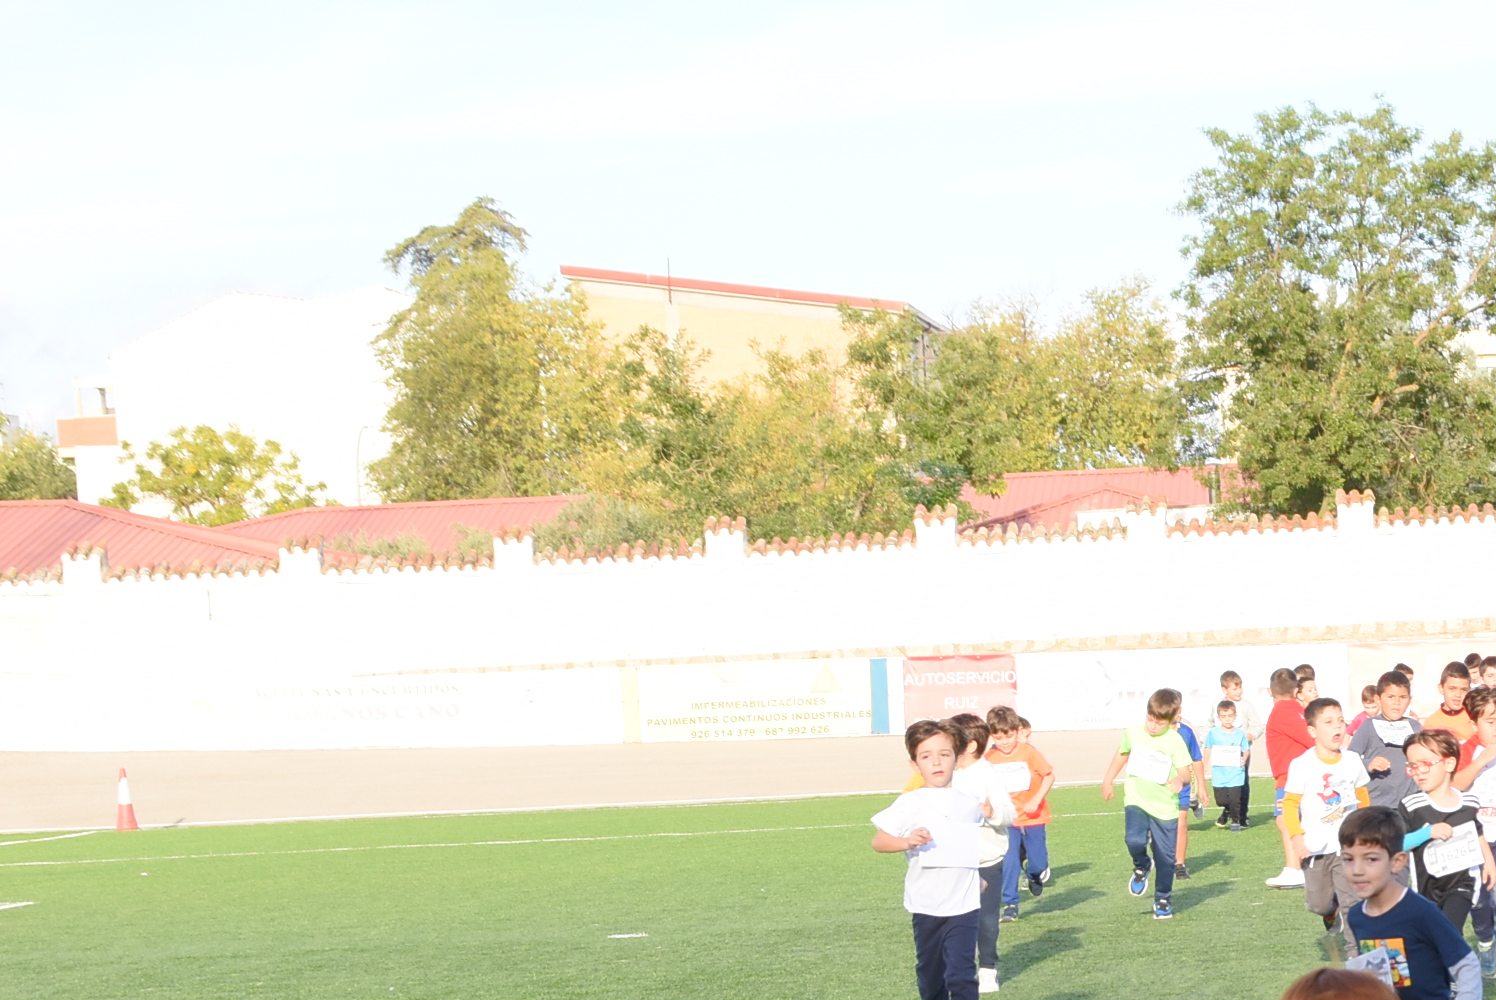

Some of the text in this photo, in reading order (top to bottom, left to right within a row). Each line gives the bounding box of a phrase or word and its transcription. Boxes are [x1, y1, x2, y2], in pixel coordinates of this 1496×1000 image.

[904, 670, 1016, 686] AUTOSERVICIO
[691, 698, 827, 711] IMPERMEABILIZACIONES
[944, 695, 979, 709] RUIZ
[647, 709, 872, 727] PAVIMENTOS CONTINUOS INDUSTRIALES
